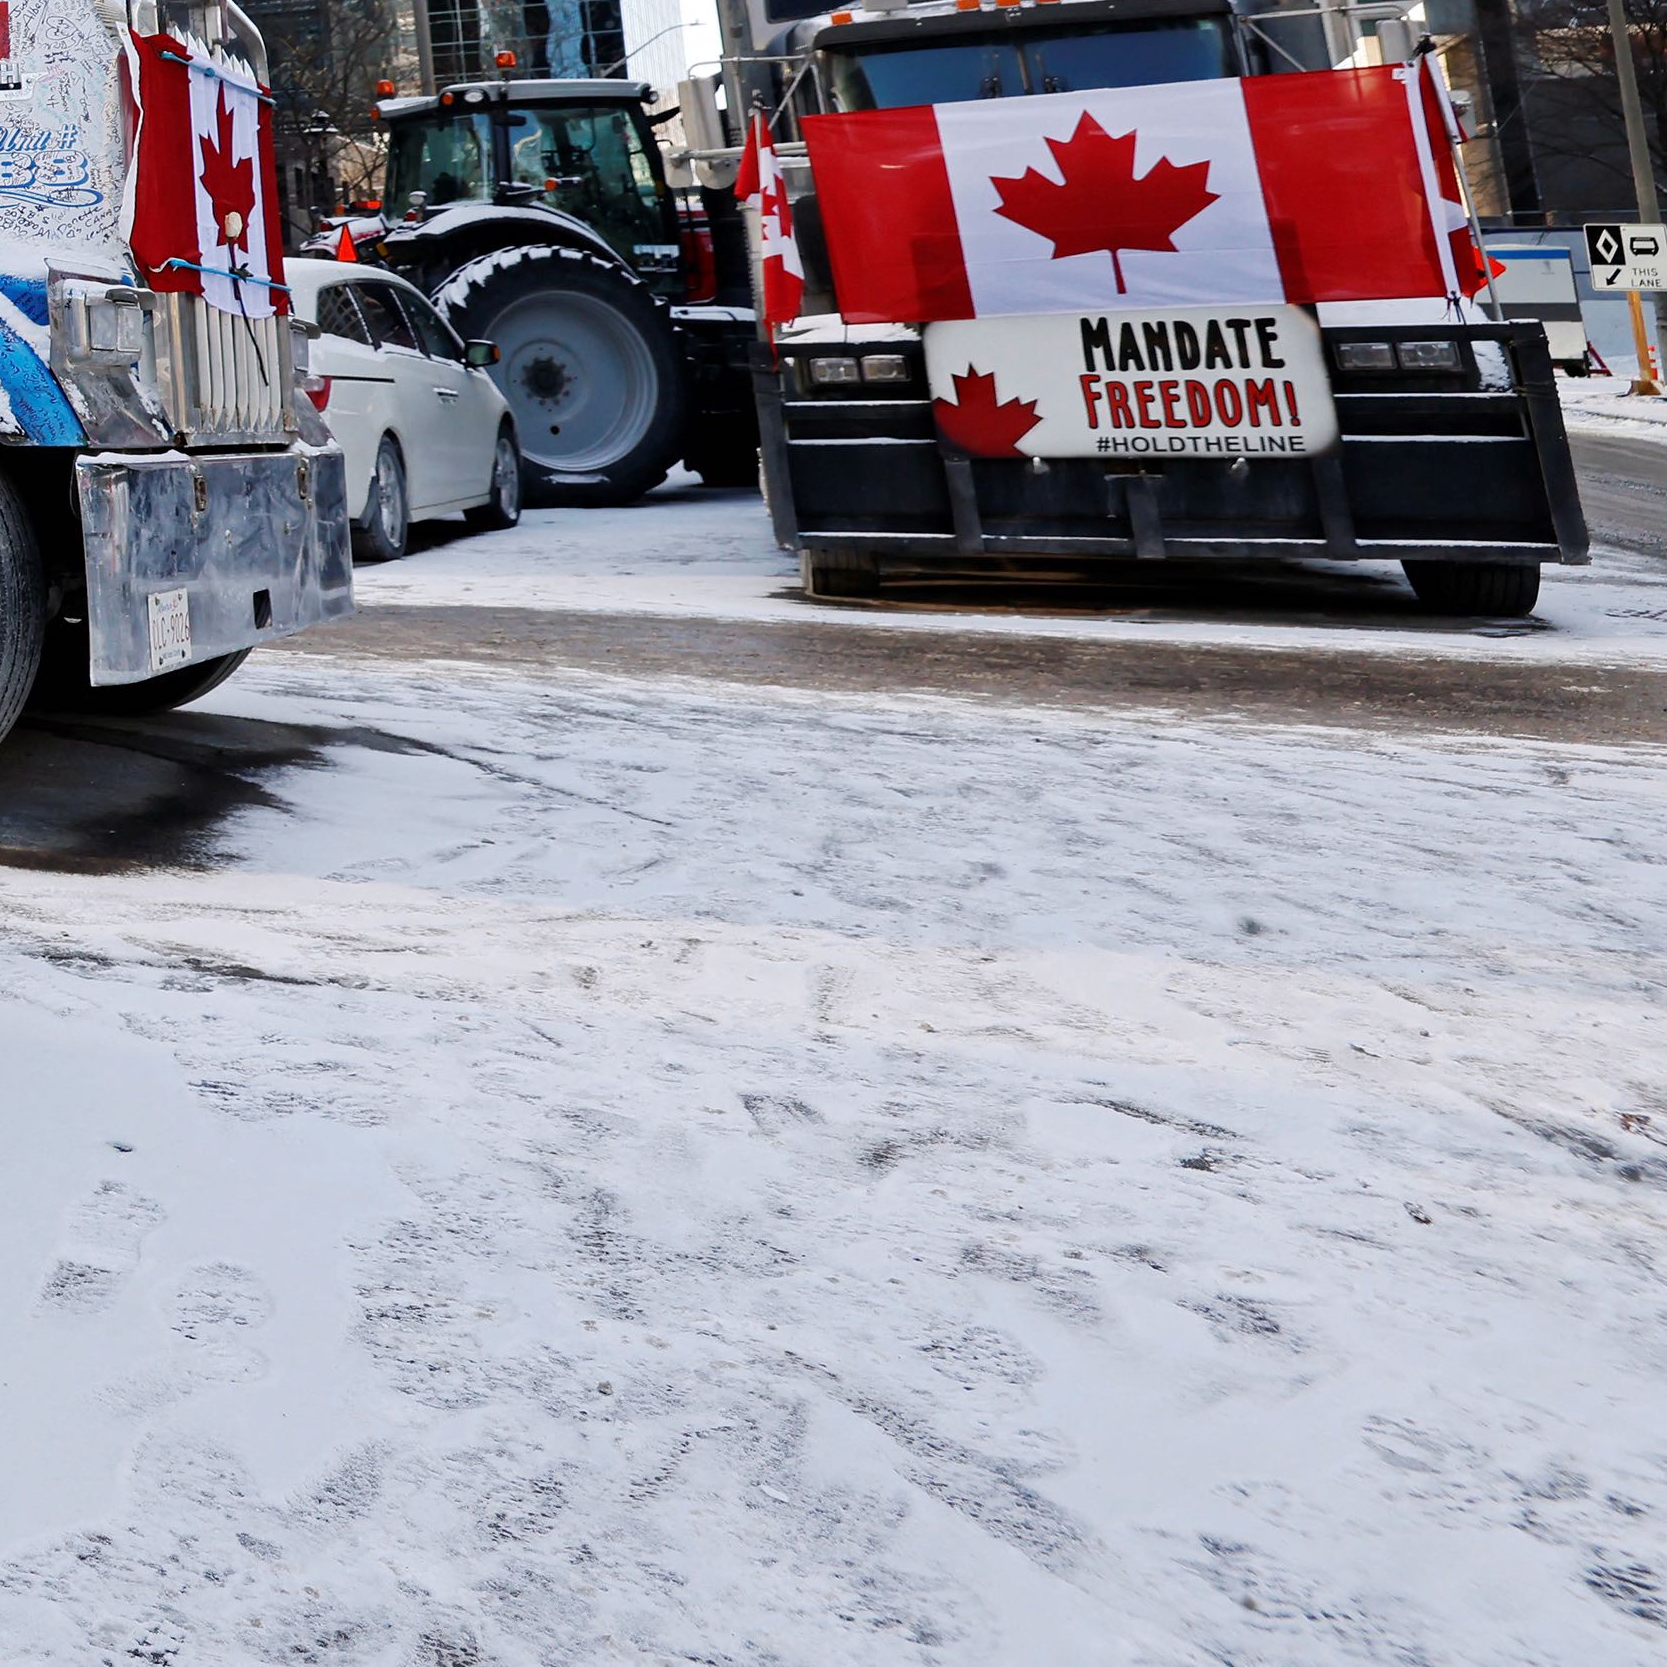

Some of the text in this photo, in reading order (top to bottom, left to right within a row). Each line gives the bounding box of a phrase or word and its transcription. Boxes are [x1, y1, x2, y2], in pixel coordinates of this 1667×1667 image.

[57, 123, 79, 149] #
[1631, 279, 1662, 287] LANE
[1632, 268, 1658, 276] THIS
[1079, 316, 1286, 372] MANDATE
[1079, 374, 1301, 429] FREEDOM!
[1096, 435, 1307, 453] #HOLDTHELINE
